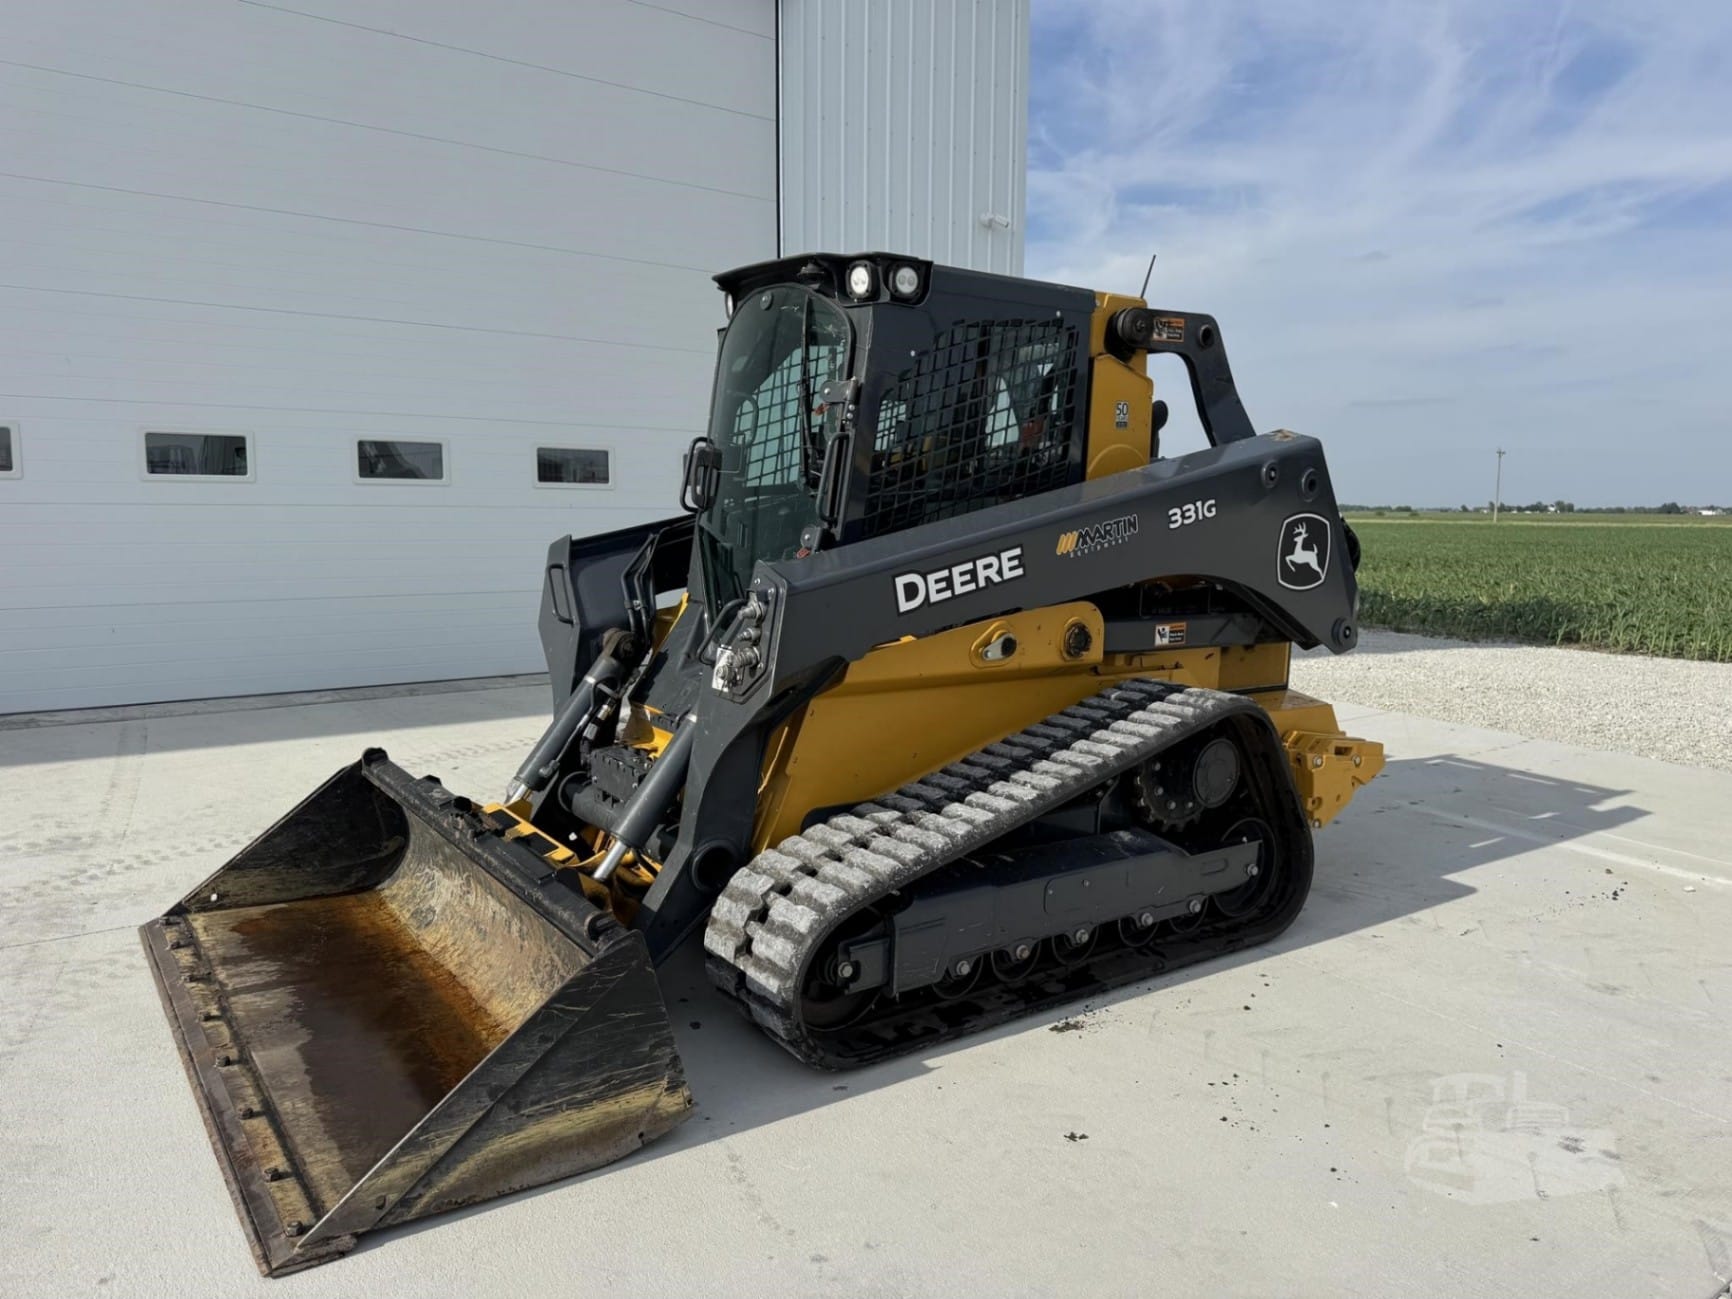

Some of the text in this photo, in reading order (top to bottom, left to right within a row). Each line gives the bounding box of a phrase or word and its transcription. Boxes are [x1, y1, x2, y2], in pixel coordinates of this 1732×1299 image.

[1076, 514, 1138, 550] MARTIN
[1168, 499, 1216, 529] 331G
[894, 547, 1024, 613] DEERE
